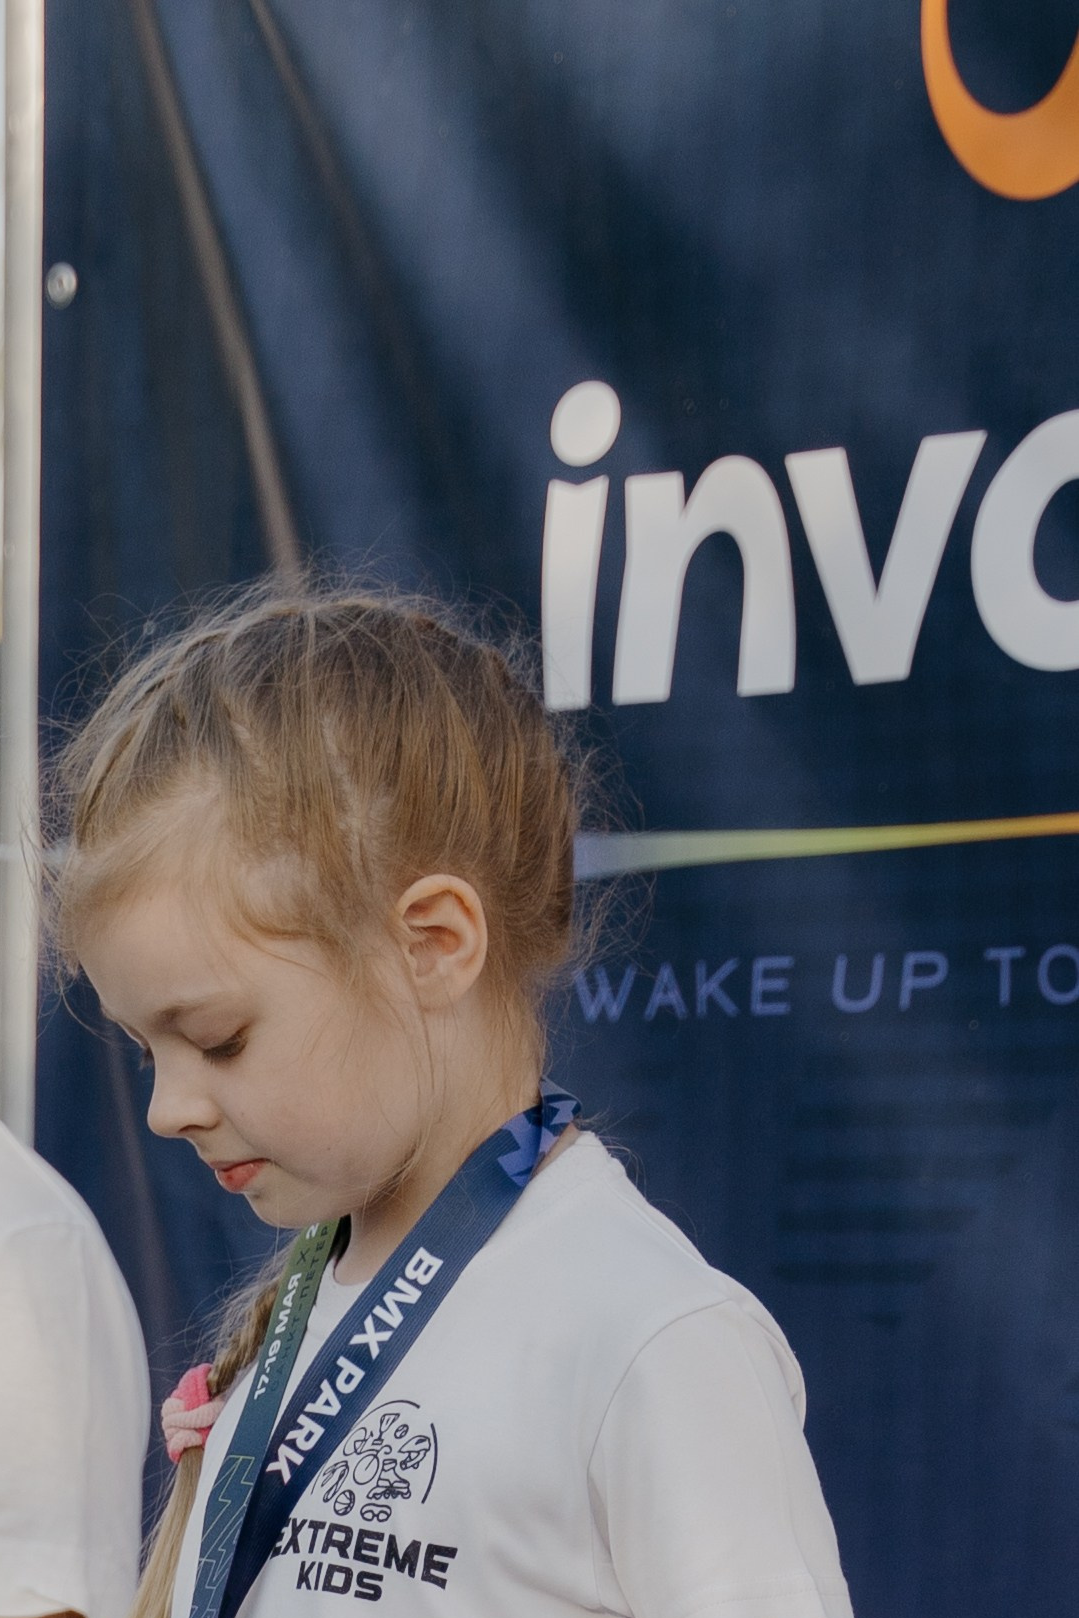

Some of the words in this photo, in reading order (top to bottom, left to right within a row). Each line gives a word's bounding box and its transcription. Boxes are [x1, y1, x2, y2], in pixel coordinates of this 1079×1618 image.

[572, 954, 796, 1025] WAKE
[831, 950, 949, 1014] UP
[984, 943, 1079, 1007] TO
[254, 1339, 282, 1401] 17-19
[274, 1272, 302, 1335] МАЯ
[349, 1247, 444, 1360] BMX
[266, 1356, 366, 1486] PARK
[296, 1560, 384, 1602] KIDS
